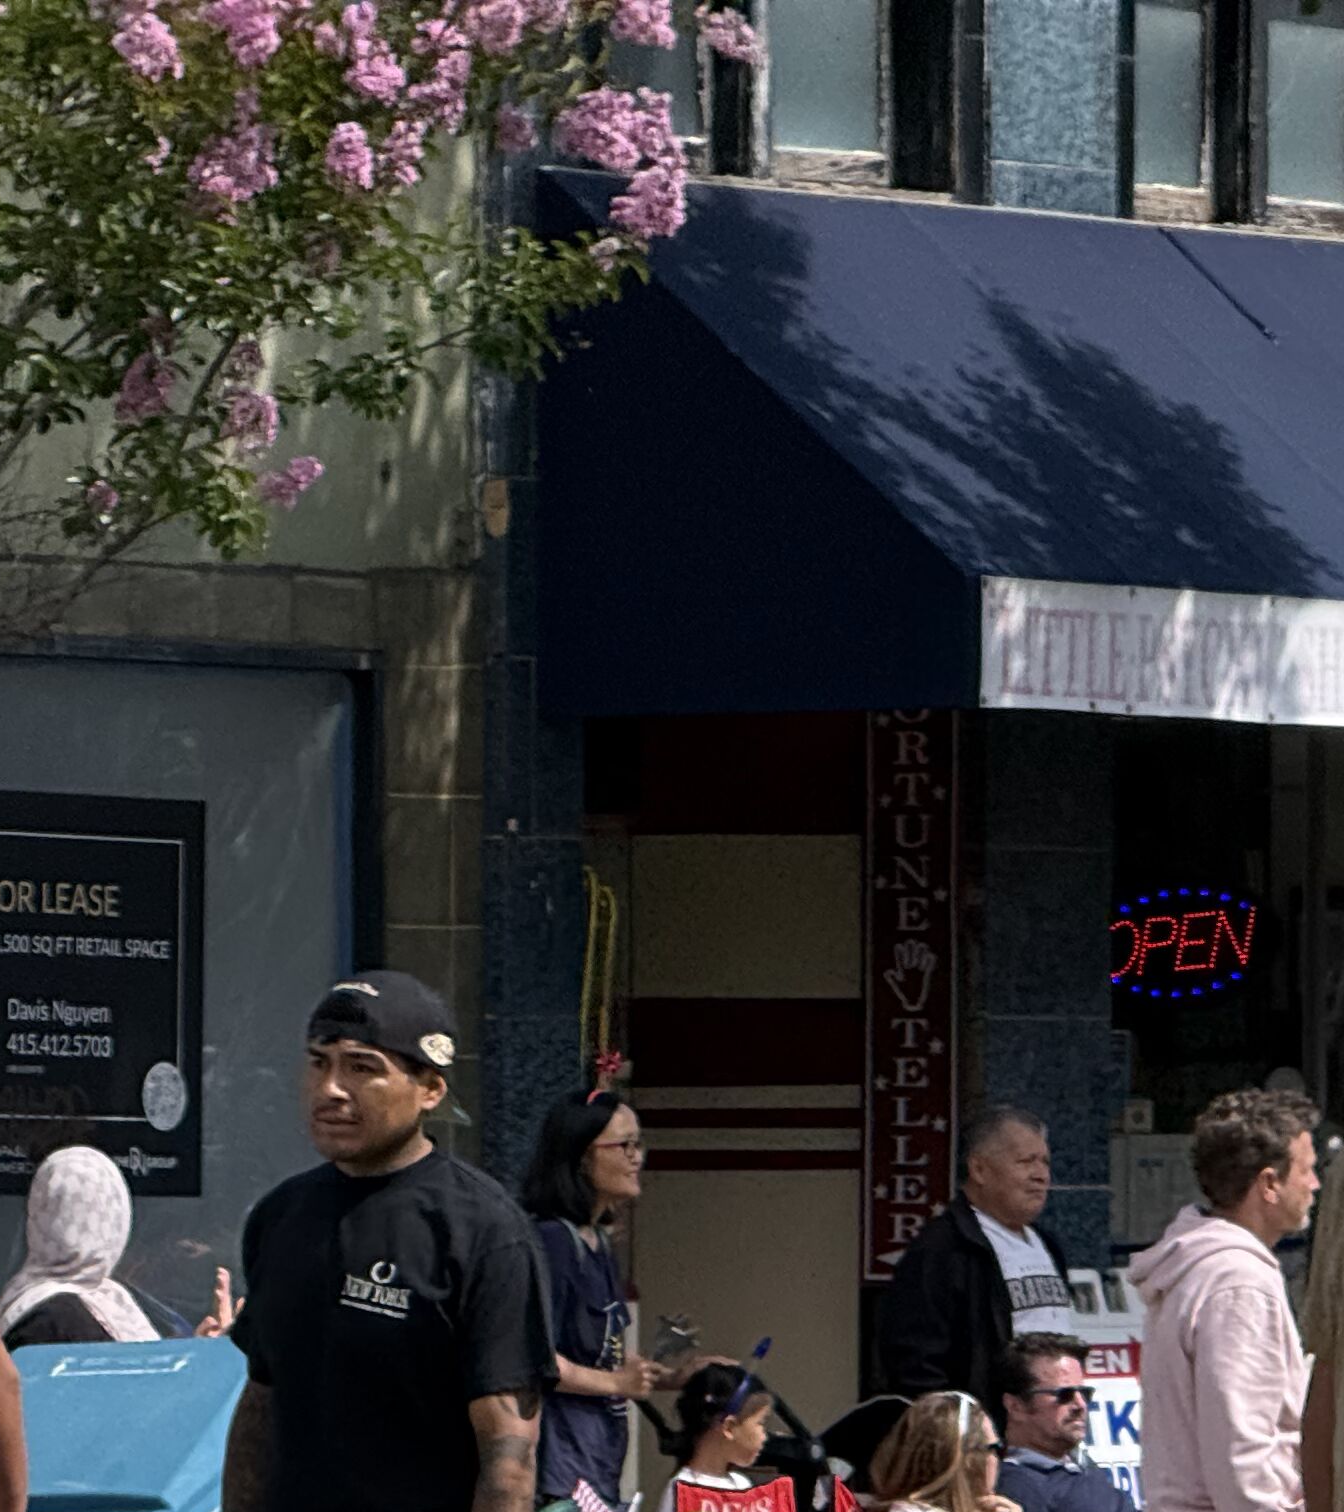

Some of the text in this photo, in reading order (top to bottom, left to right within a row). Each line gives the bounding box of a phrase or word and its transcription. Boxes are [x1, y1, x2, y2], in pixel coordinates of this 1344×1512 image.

[41, 882, 121, 918] LEASE
[32, 936, 54, 957] SQ
[56, 937, 75, 955] FT
[75, 938, 123, 957] RETAIL
[124, 940, 171, 960] SPACE
[886, 709, 932, 1244] RTUNE TELLER
[7, 998, 113, 1027] Davis Nguyen
[6, 1033, 116, 1059] 415.412.5703
